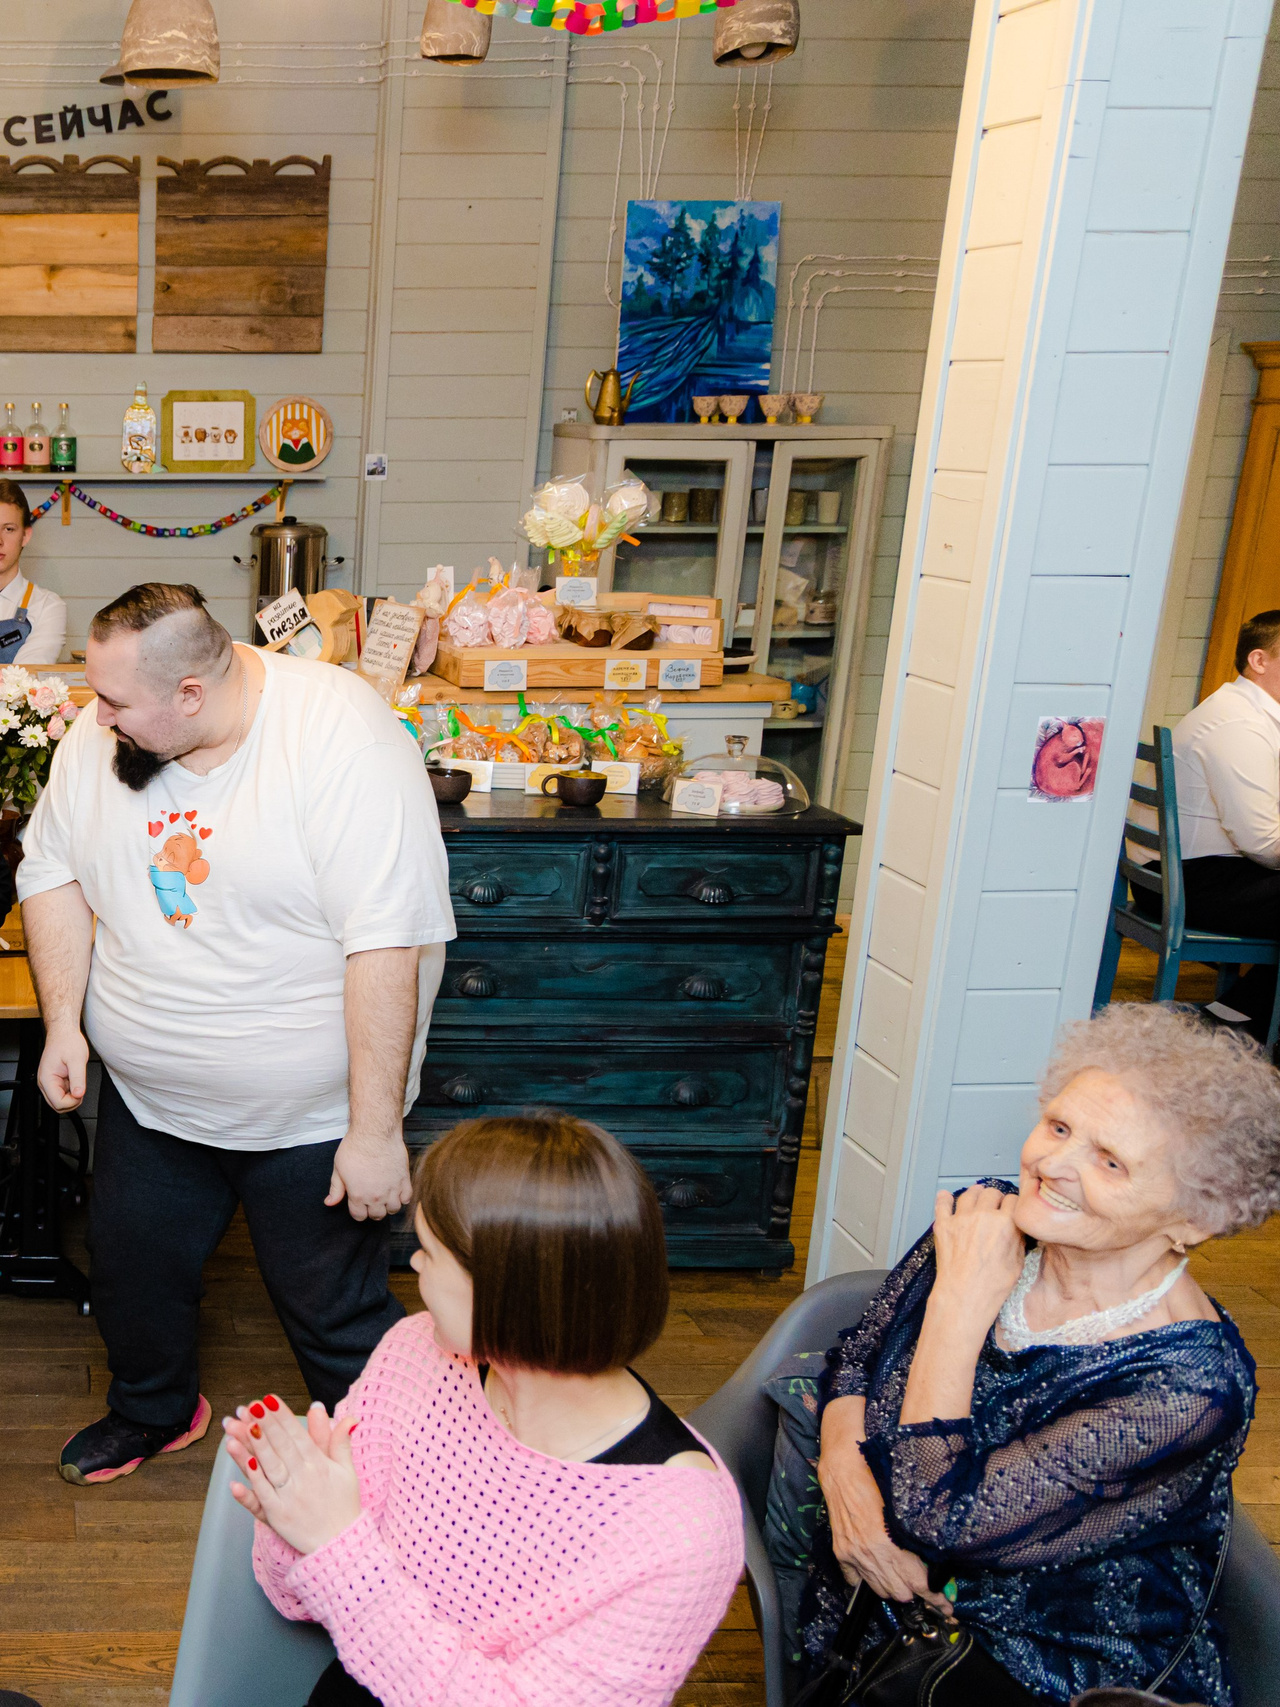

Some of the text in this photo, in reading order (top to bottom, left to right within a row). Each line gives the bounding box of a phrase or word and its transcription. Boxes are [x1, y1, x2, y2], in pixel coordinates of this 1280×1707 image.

[2, 90, 174, 147] СЕЙЧАС
[267, 601, 297, 626] развитие
[272, 602, 282, 611] на
